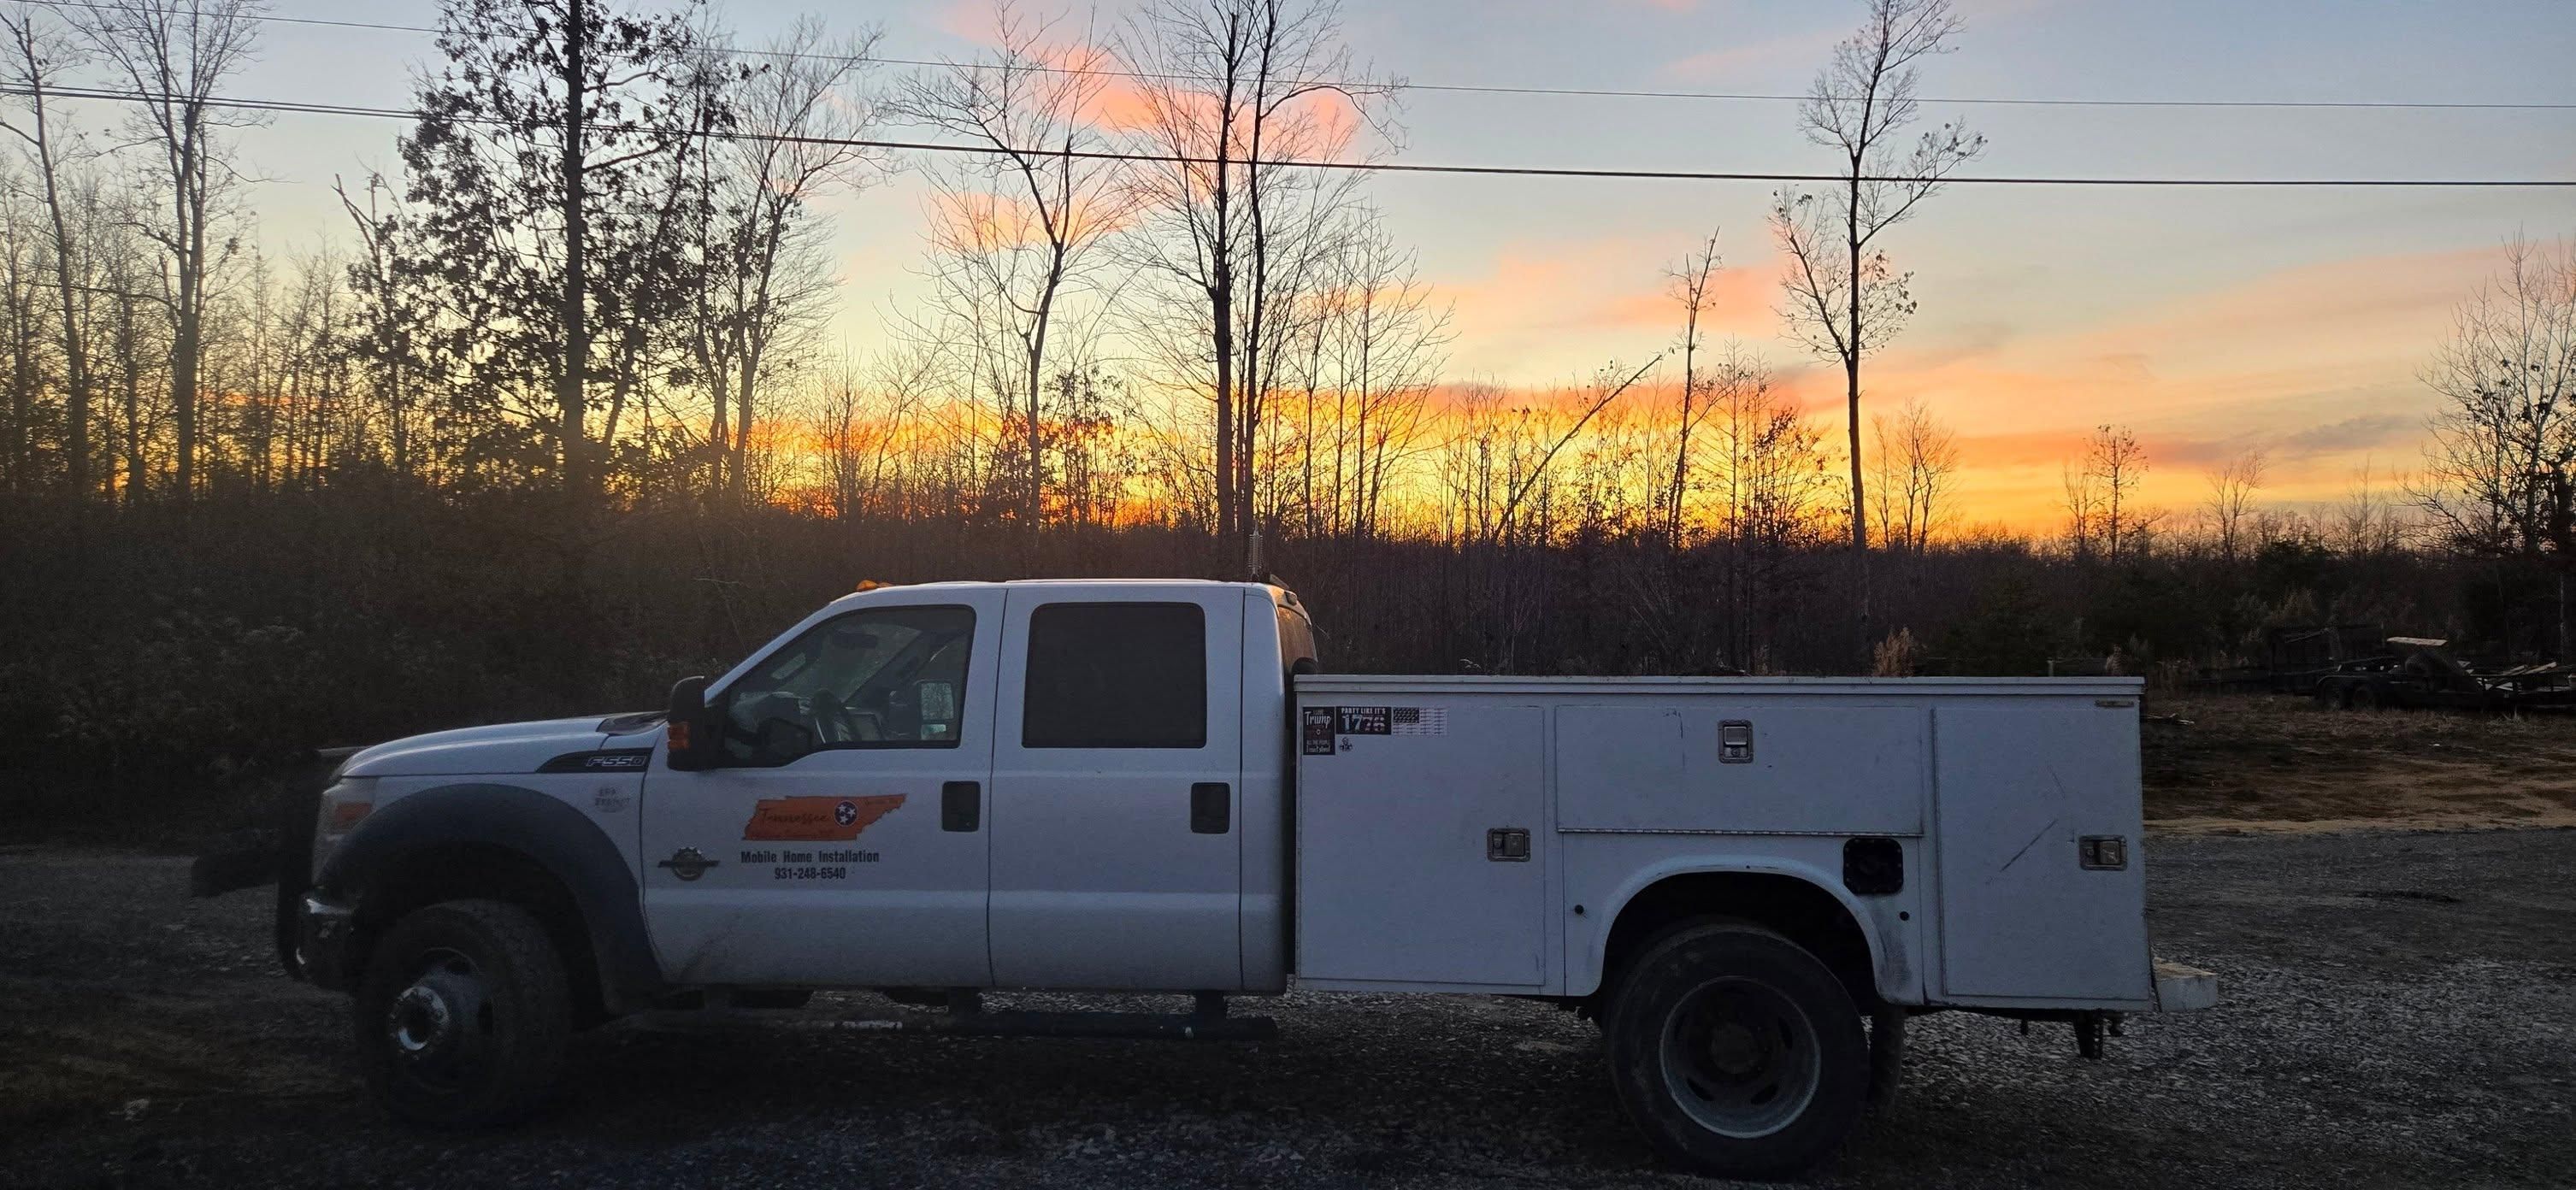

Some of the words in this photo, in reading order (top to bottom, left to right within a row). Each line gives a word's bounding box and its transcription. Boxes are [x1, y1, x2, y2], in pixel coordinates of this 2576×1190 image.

[1305, 711, 1331, 728] Trump
[1341, 715, 1385, 733] 1776
[758, 807, 830, 825] Tennessee
[740, 851, 777, 863] Mobile
[783, 850, 812, 863] Home
[818, 849, 880, 863] Installation
[774, 867, 846, 880] 931-248-6540
